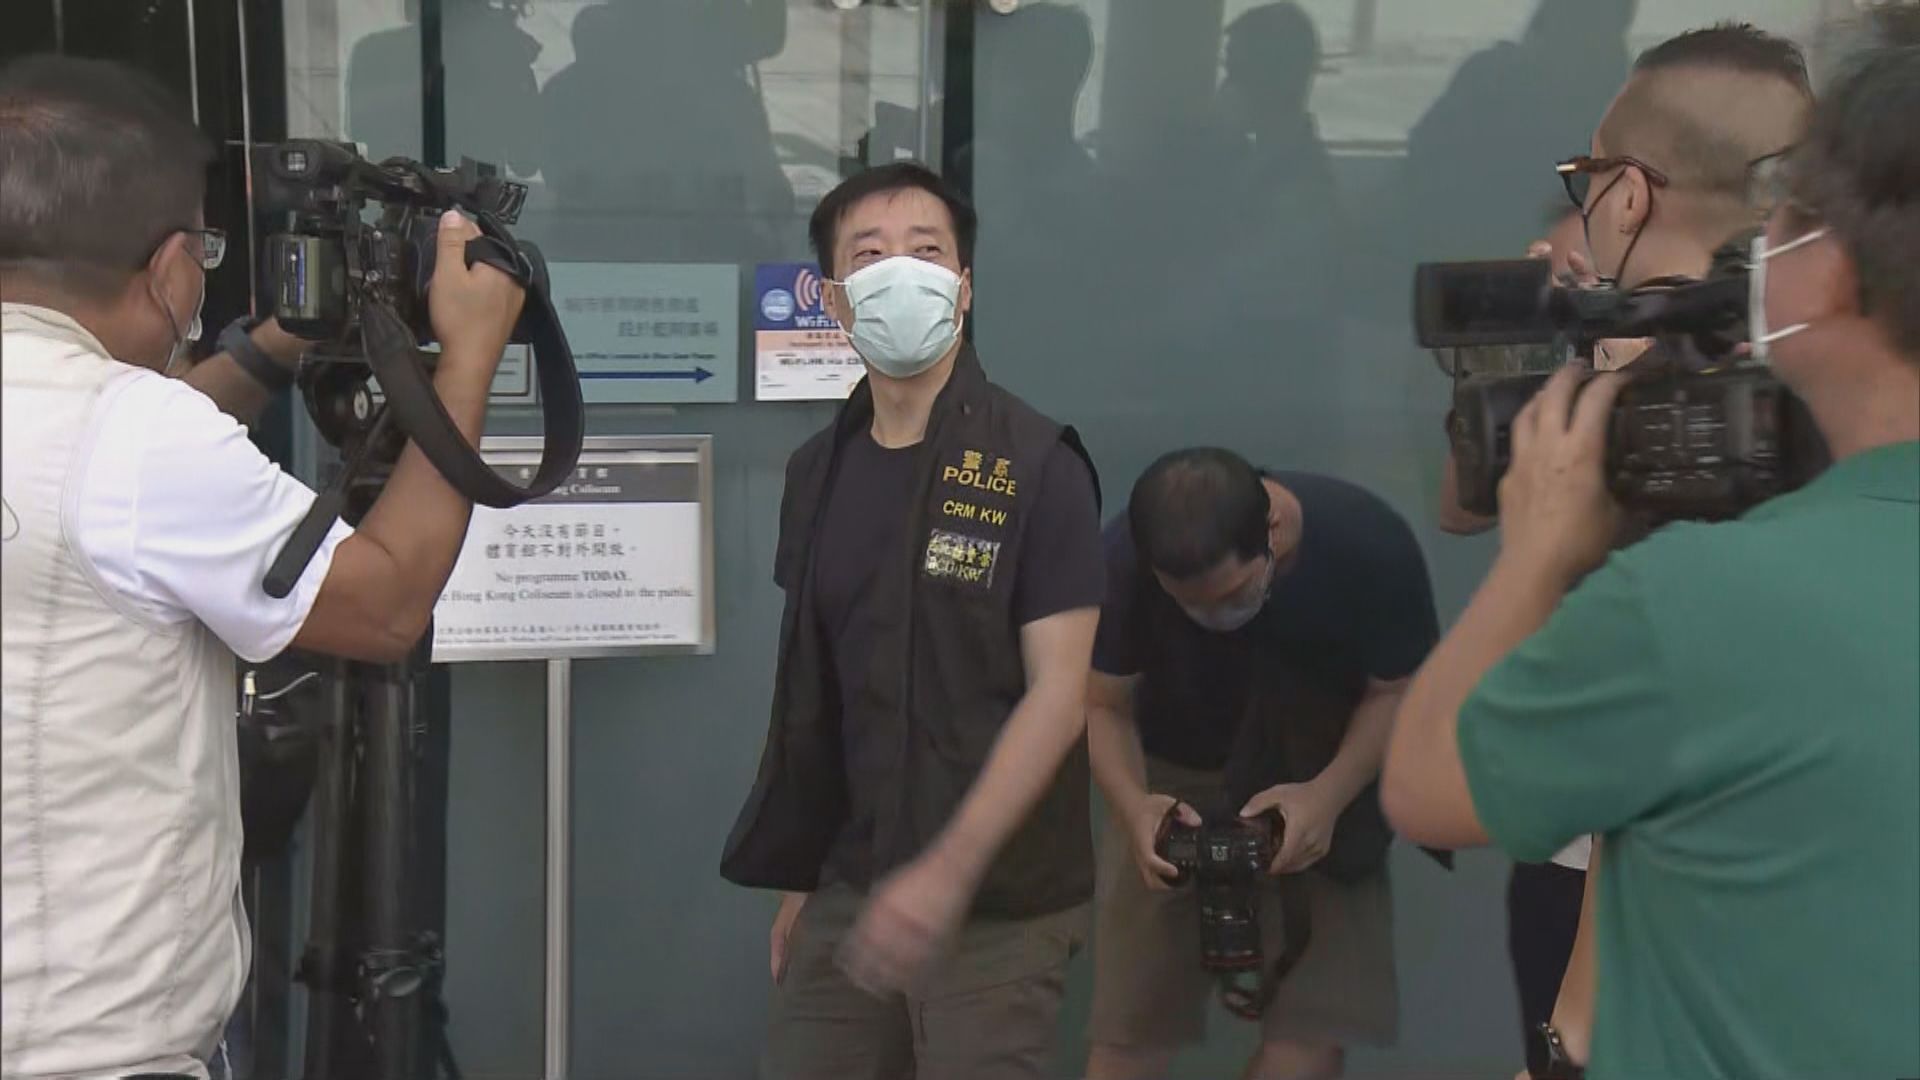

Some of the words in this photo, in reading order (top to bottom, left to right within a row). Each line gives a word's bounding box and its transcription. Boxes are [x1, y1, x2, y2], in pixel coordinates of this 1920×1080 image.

[570, 483, 622, 494] Coliseum
[943, 466, 1017, 496] POLICE
[943, 500, 976, 519] CRM
[979, 508, 1008, 526] KW
[495, 571, 514, 582] No
[515, 573, 579, 585] programme
[451, 590, 482, 603] Hong
[485, 590, 516, 602] Kong
[518, 588, 573, 599] Coliseum
[587, 586, 622, 599] closed
